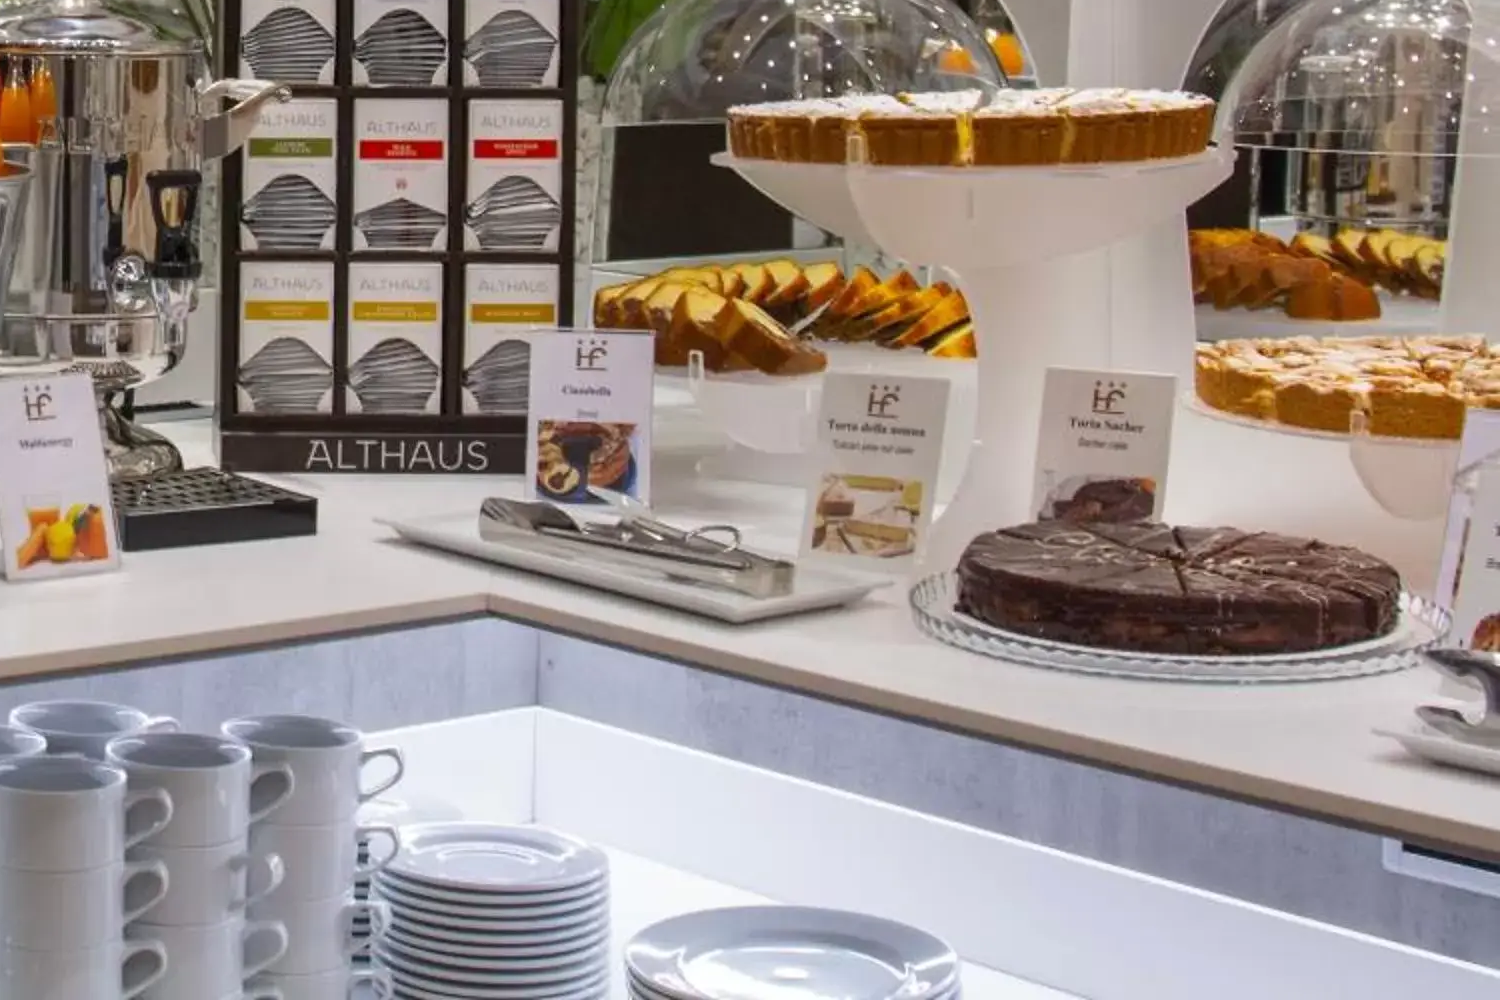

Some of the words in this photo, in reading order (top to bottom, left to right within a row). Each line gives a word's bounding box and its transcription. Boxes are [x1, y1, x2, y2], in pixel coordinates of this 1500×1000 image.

[258, 113, 327, 128] ALTHAUS
[367, 120, 439, 135] ALTHAUS
[480, 114, 550, 129] ALTHAUS
[252, 276, 323, 291] ALTHAUS
[360, 276, 432, 292] ALTHAUS
[478, 278, 549, 293] ALTHAUS
[305, 438, 490, 471] ALTHAUS
